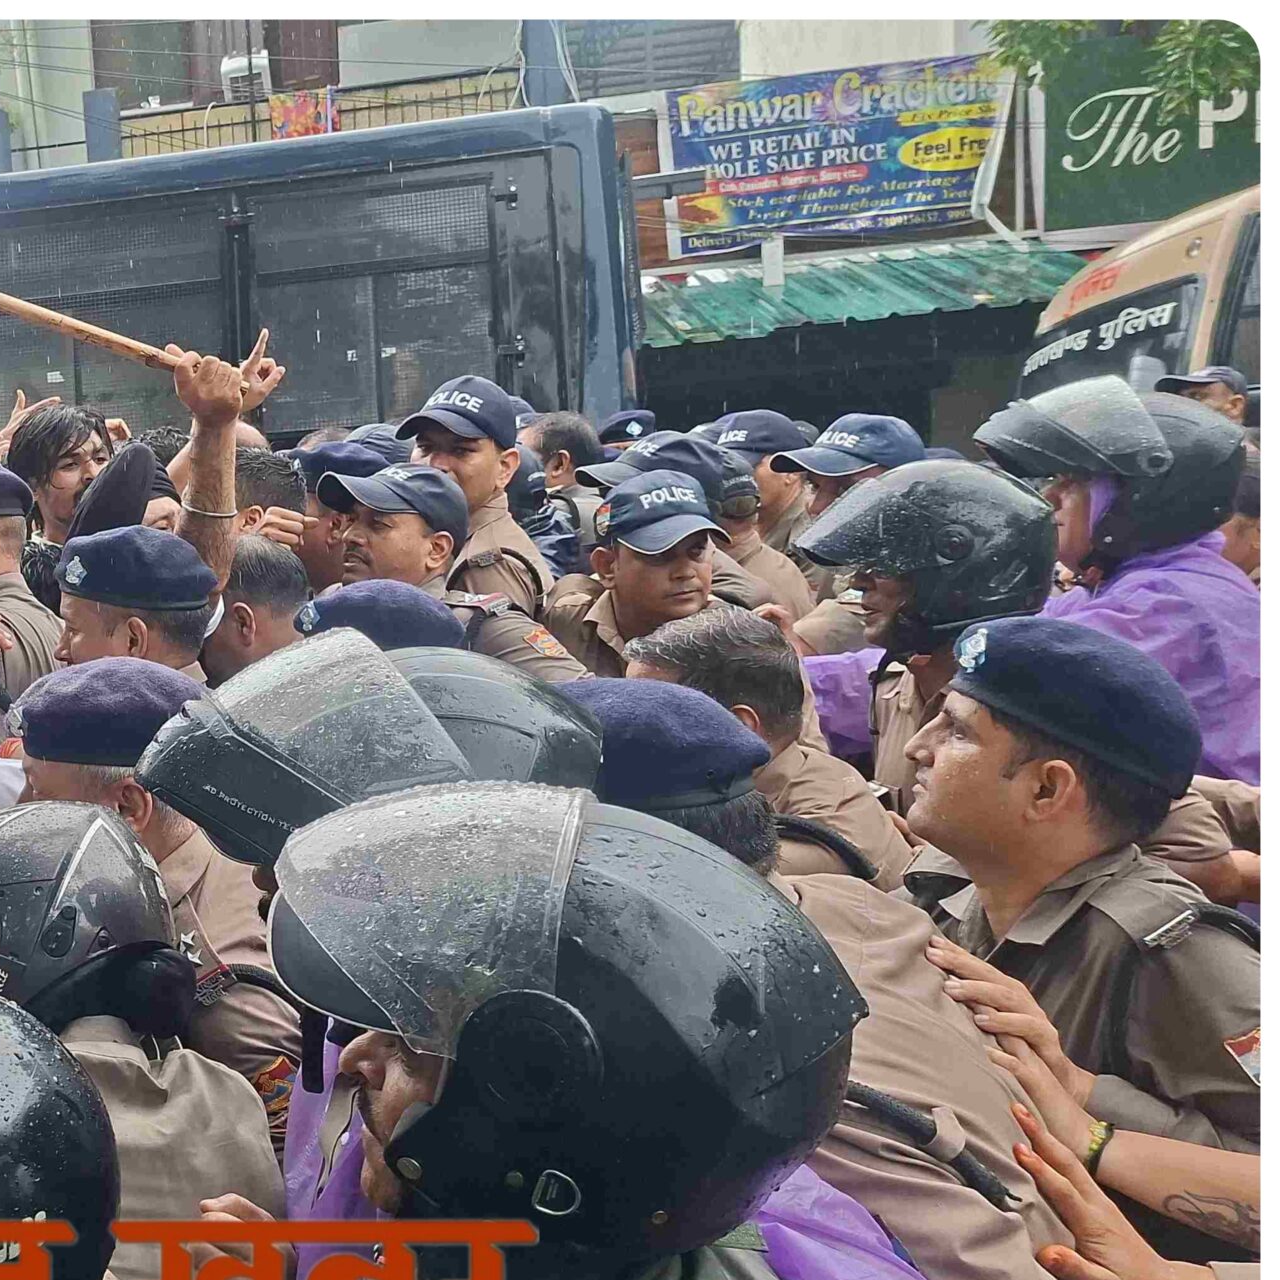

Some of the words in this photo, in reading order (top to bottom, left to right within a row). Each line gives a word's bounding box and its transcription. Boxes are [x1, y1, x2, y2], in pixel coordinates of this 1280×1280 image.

[677, 90, 823, 137] Panwar
[1062, 86, 1183, 172] The
[708, 141, 742, 161] WE
[749, 131, 825, 157] RETAIL
[831, 127, 857, 145] IN
[914, 138, 951, 157] Feel
[704, 157, 760, 181] HOLE
[767, 152, 816, 174] SALE
[821, 143, 888, 166] PRICE
[904, 191, 936, 204] The
[689, 235, 732, 249] Delivery
[1097, 302, 1179, 351] पुलिस
[639, 485, 699, 510] POLICE
[218, 791, 276, 825] PROTECTION
